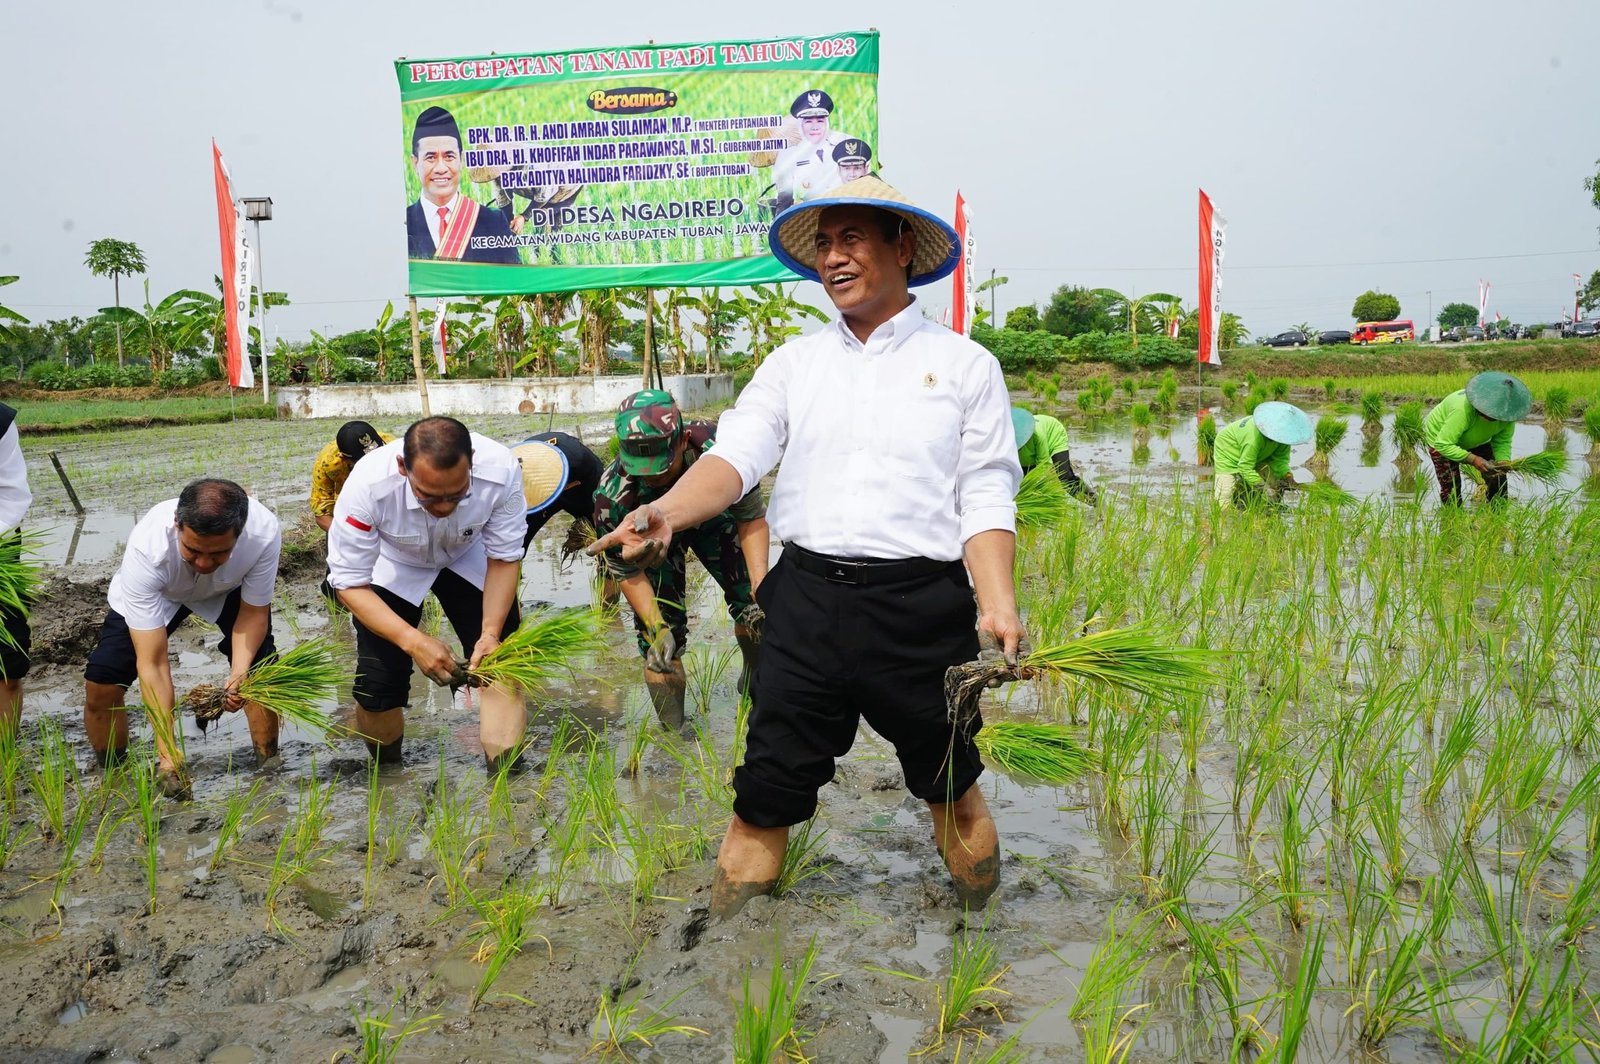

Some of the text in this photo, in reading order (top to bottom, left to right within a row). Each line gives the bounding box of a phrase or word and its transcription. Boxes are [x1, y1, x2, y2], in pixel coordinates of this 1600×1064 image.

[411, 38, 856, 82] PERCEPATAN TANAM PADI TAHUN 2023
[468, 128, 493, 144] BPK.
[495, 126, 512, 143] DR.
[514, 126, 528, 141] IR.
[530, 125, 541, 140] H.
[543, 123, 568, 140] ANDI
[571, 121, 609, 138] AMRAN
[611, 118, 670, 136] SULAIMAN,
[672, 117, 692, 133] M.P.
[731, 117, 769, 130] PERTANIAN
[466, 151, 484, 167] IBU
[487, 149, 511, 166] DRA.
[513, 149, 528, 164] HJ.
[529, 146, 580, 163] KHOFIFAH
[583, 144, 616, 160] INDAR
[619, 140, 689, 159] PARAWANSA,
[691, 138, 717, 155] M.SI.
[502, 171, 526, 188] BPK.
[528, 169, 566, 186] ADITYA
[568, 166, 620, 184] HALINDRA
[623, 163, 675, 181] FARIDZKY,
[677, 162, 690, 178] SE
[533, 198, 744, 227] DI DESA NGADIREJO
[471, 235, 545, 249] KECAMATAN
[549, 231, 600, 244] WIDANG
[605, 228, 676, 242] KABUPATEN
[680, 225, 723, 238] TUBAN
[735, 223, 768, 236] JAWA
